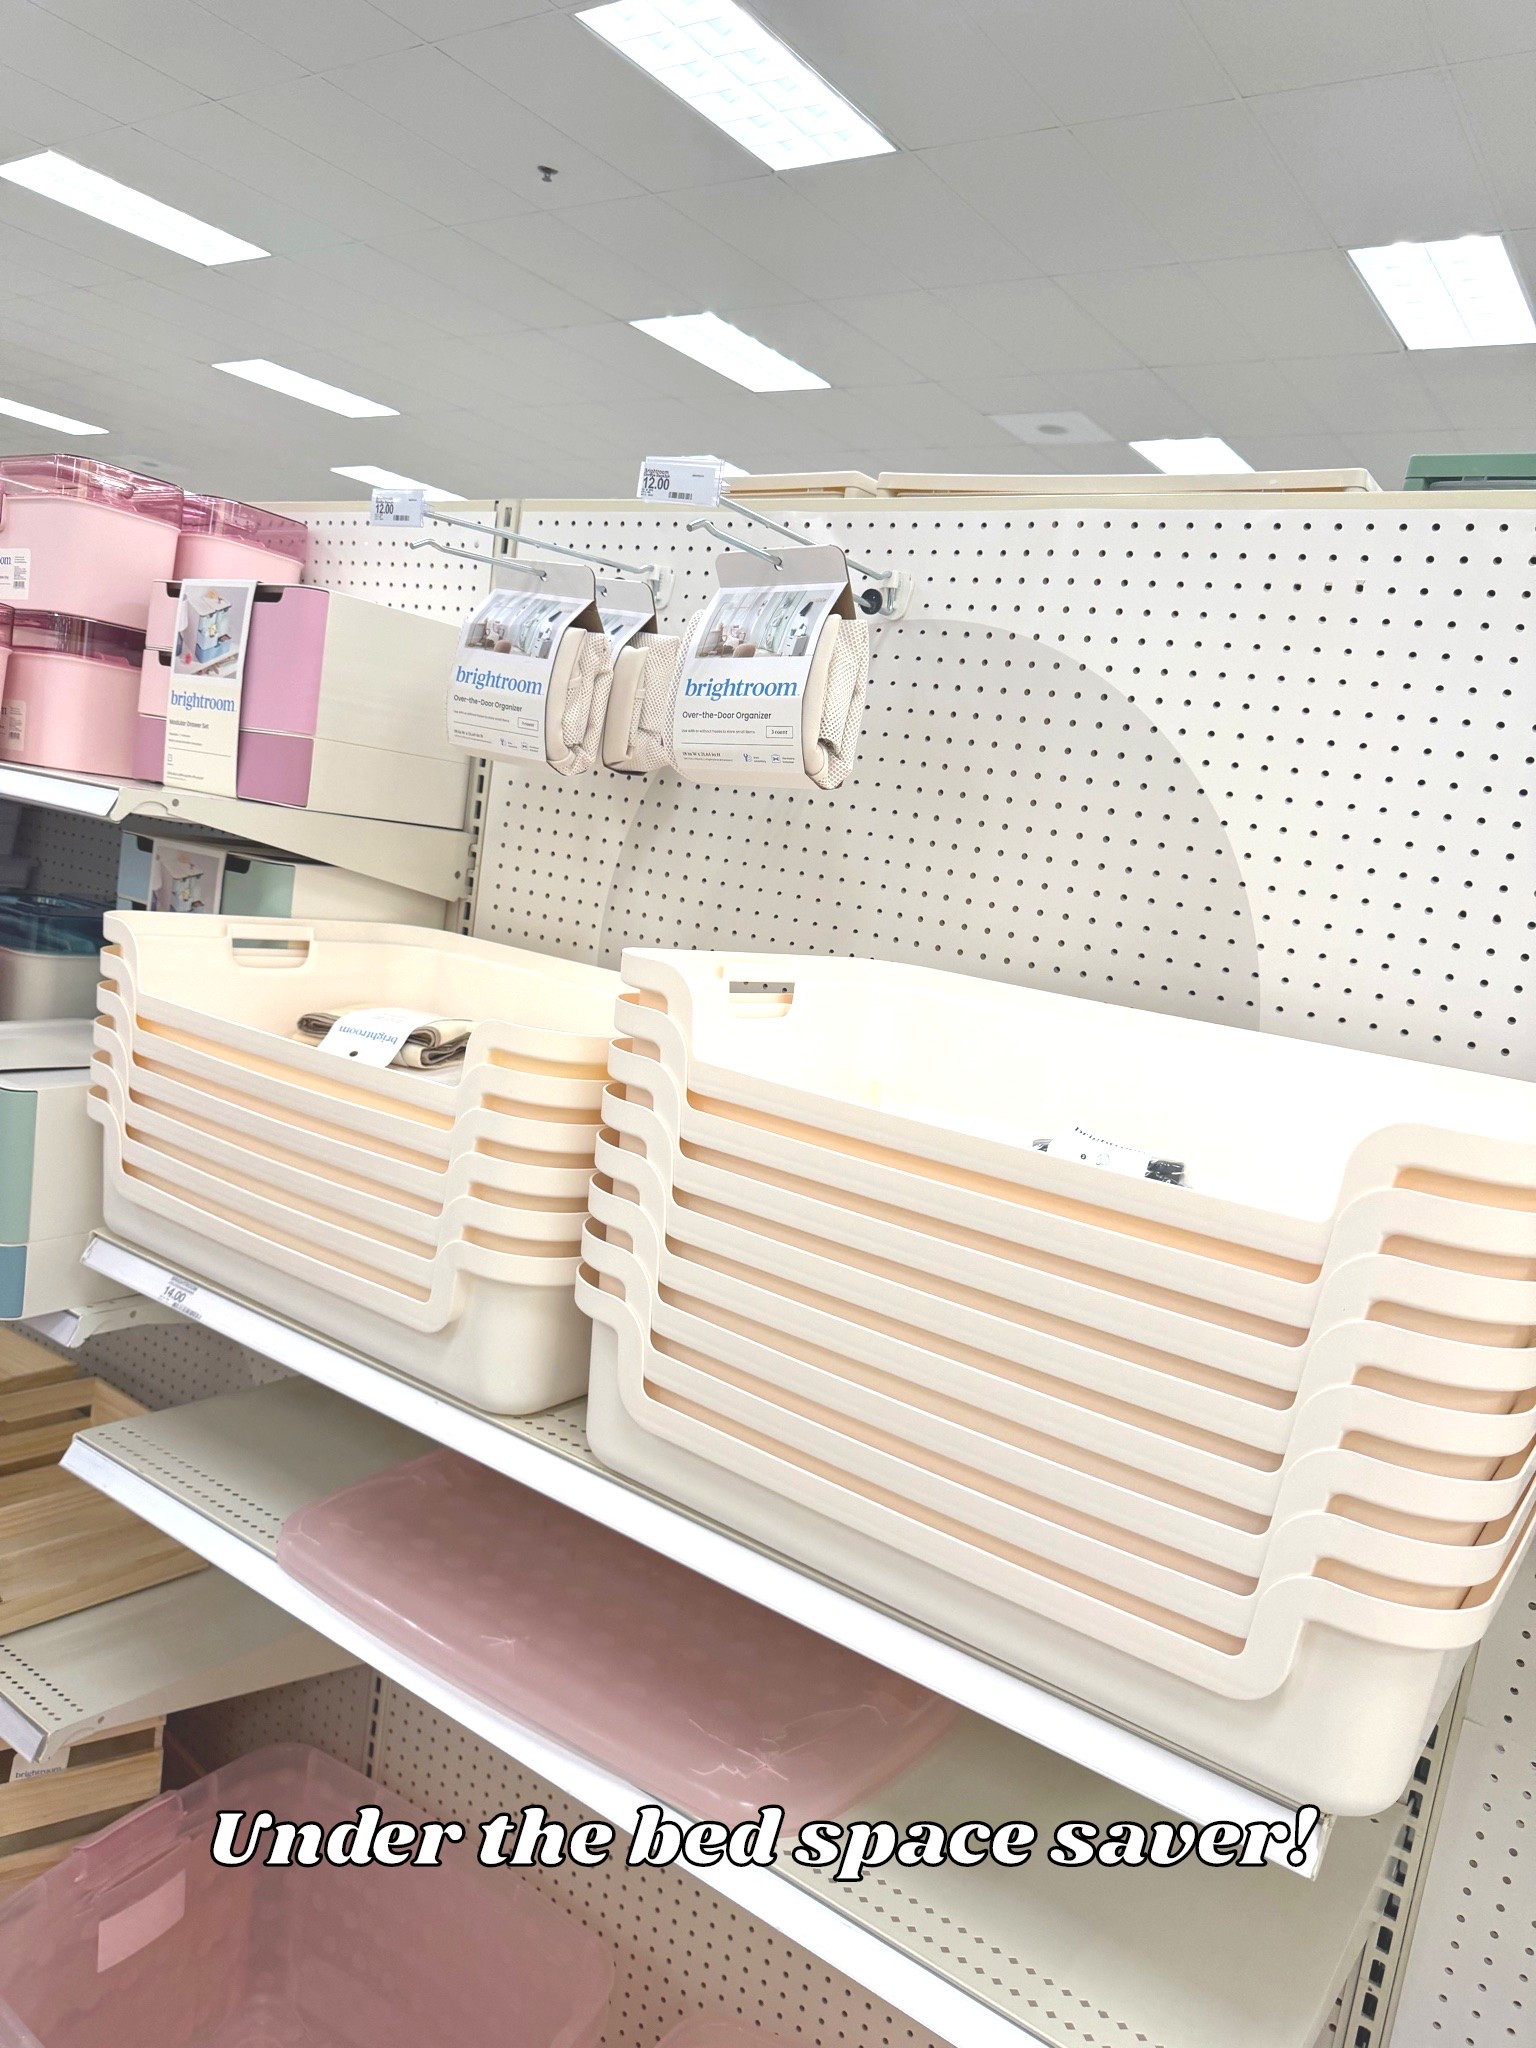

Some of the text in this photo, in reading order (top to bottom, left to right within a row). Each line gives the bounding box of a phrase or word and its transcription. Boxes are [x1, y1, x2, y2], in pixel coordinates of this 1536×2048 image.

[643, 476, 670, 490] 12.00
[375, 503, 394, 514] 12.00
[456, 665, 542, 696] brightroom
[684, 677, 798, 701] brightroom
[170, 689, 236, 712] brightroom
[453, 694, 523, 712] Over-the-Door Organizer
[682, 710, 772, 722] Over-the-Door Organizer
[339, 1025, 399, 1045] brightroom
[163, 1286, 187, 1303] 14.00
